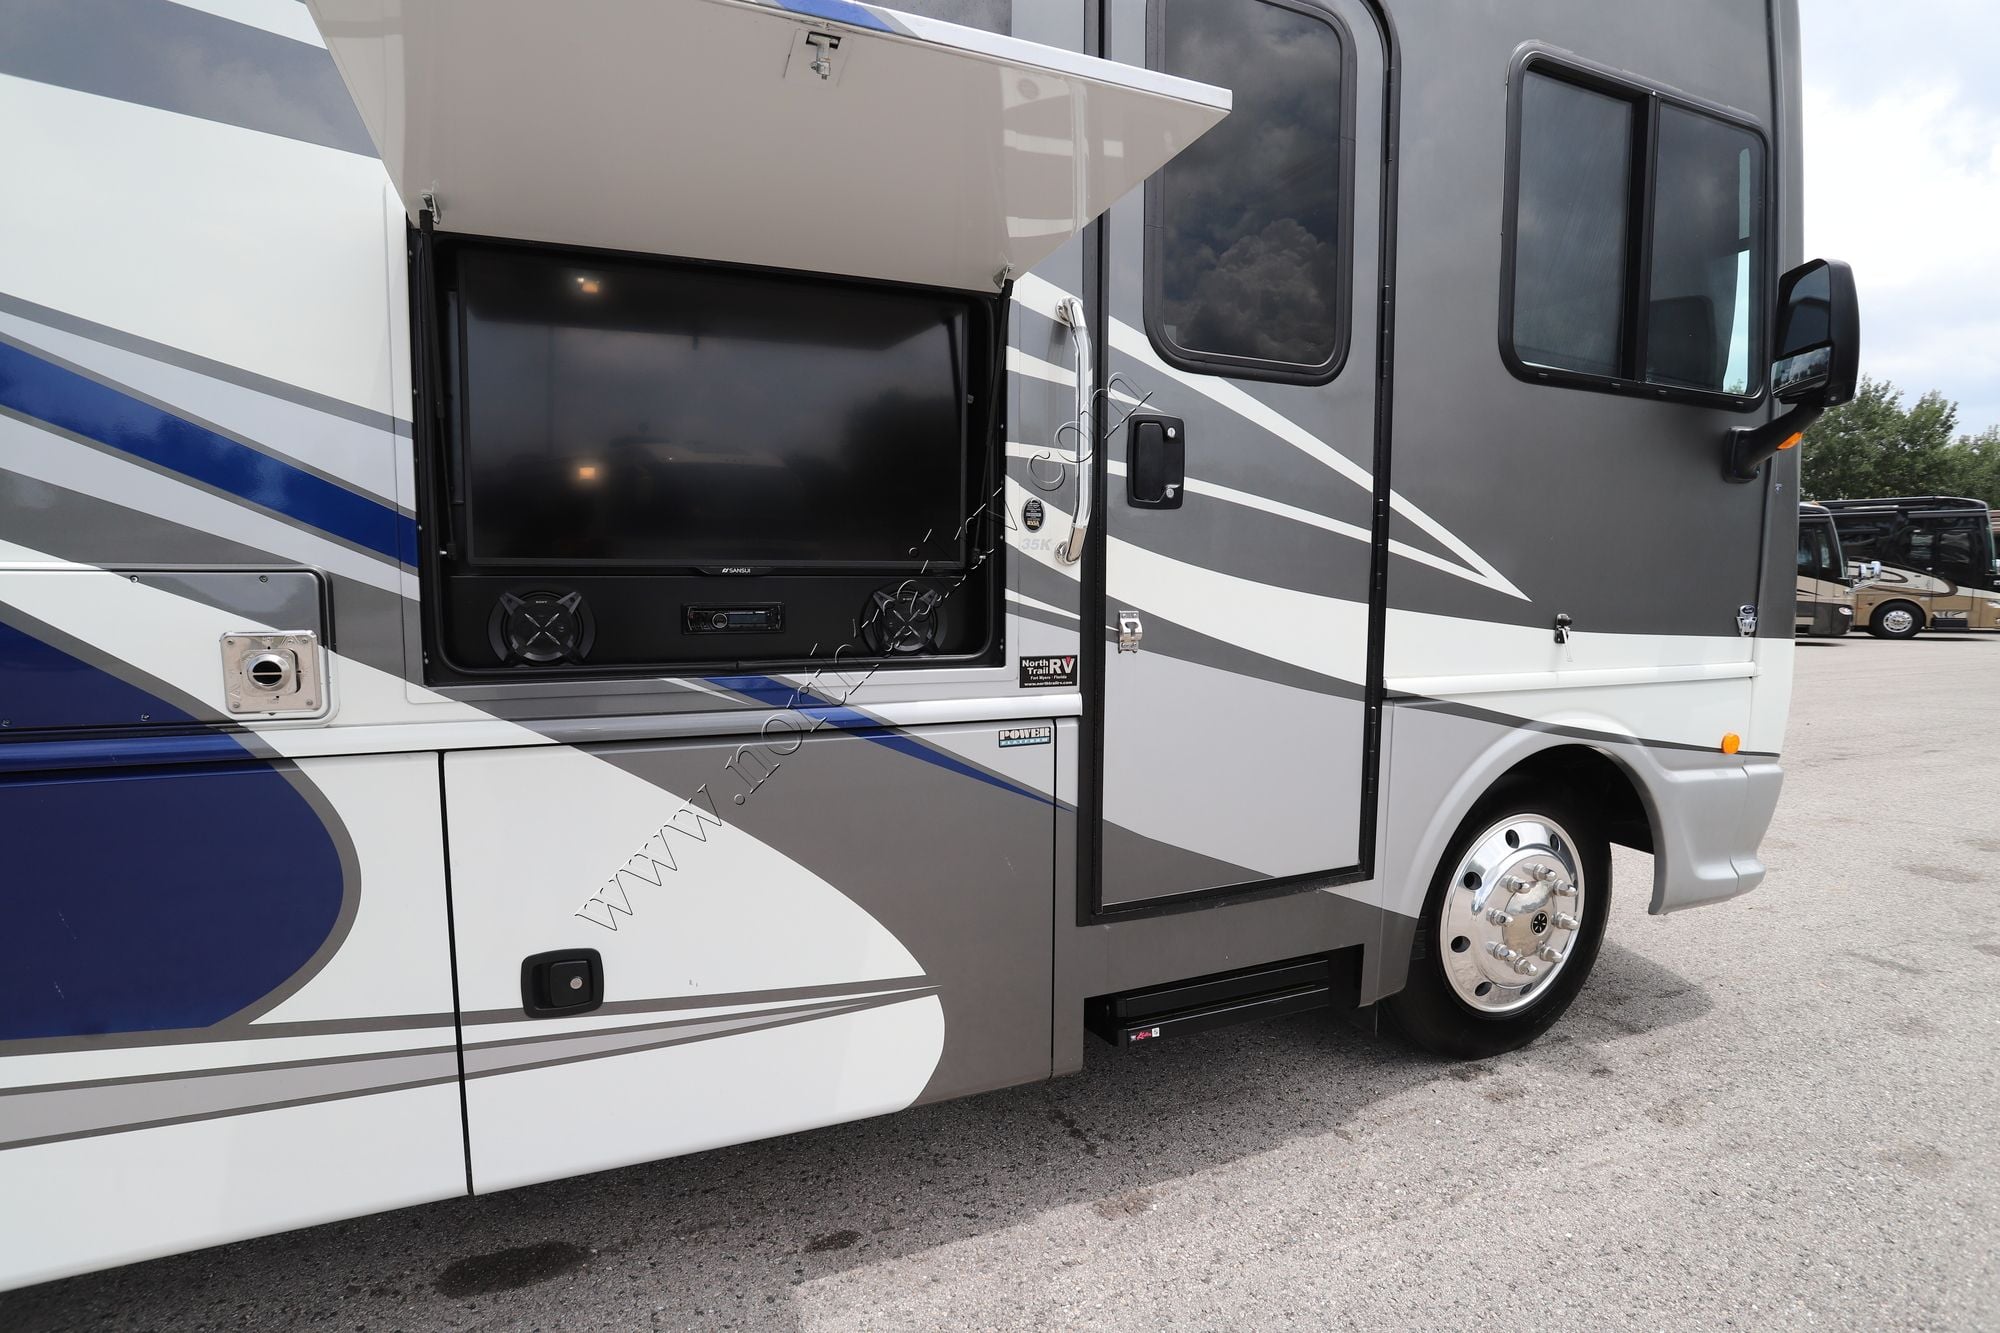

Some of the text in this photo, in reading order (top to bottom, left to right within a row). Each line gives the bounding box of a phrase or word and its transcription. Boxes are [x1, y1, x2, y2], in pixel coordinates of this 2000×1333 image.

[1021, 538, 1052, 551] 35K
[1022, 659, 1048, 667] North
[1049, 657, 1075, 674] RV
[999, 727, 1050, 740] POWER
